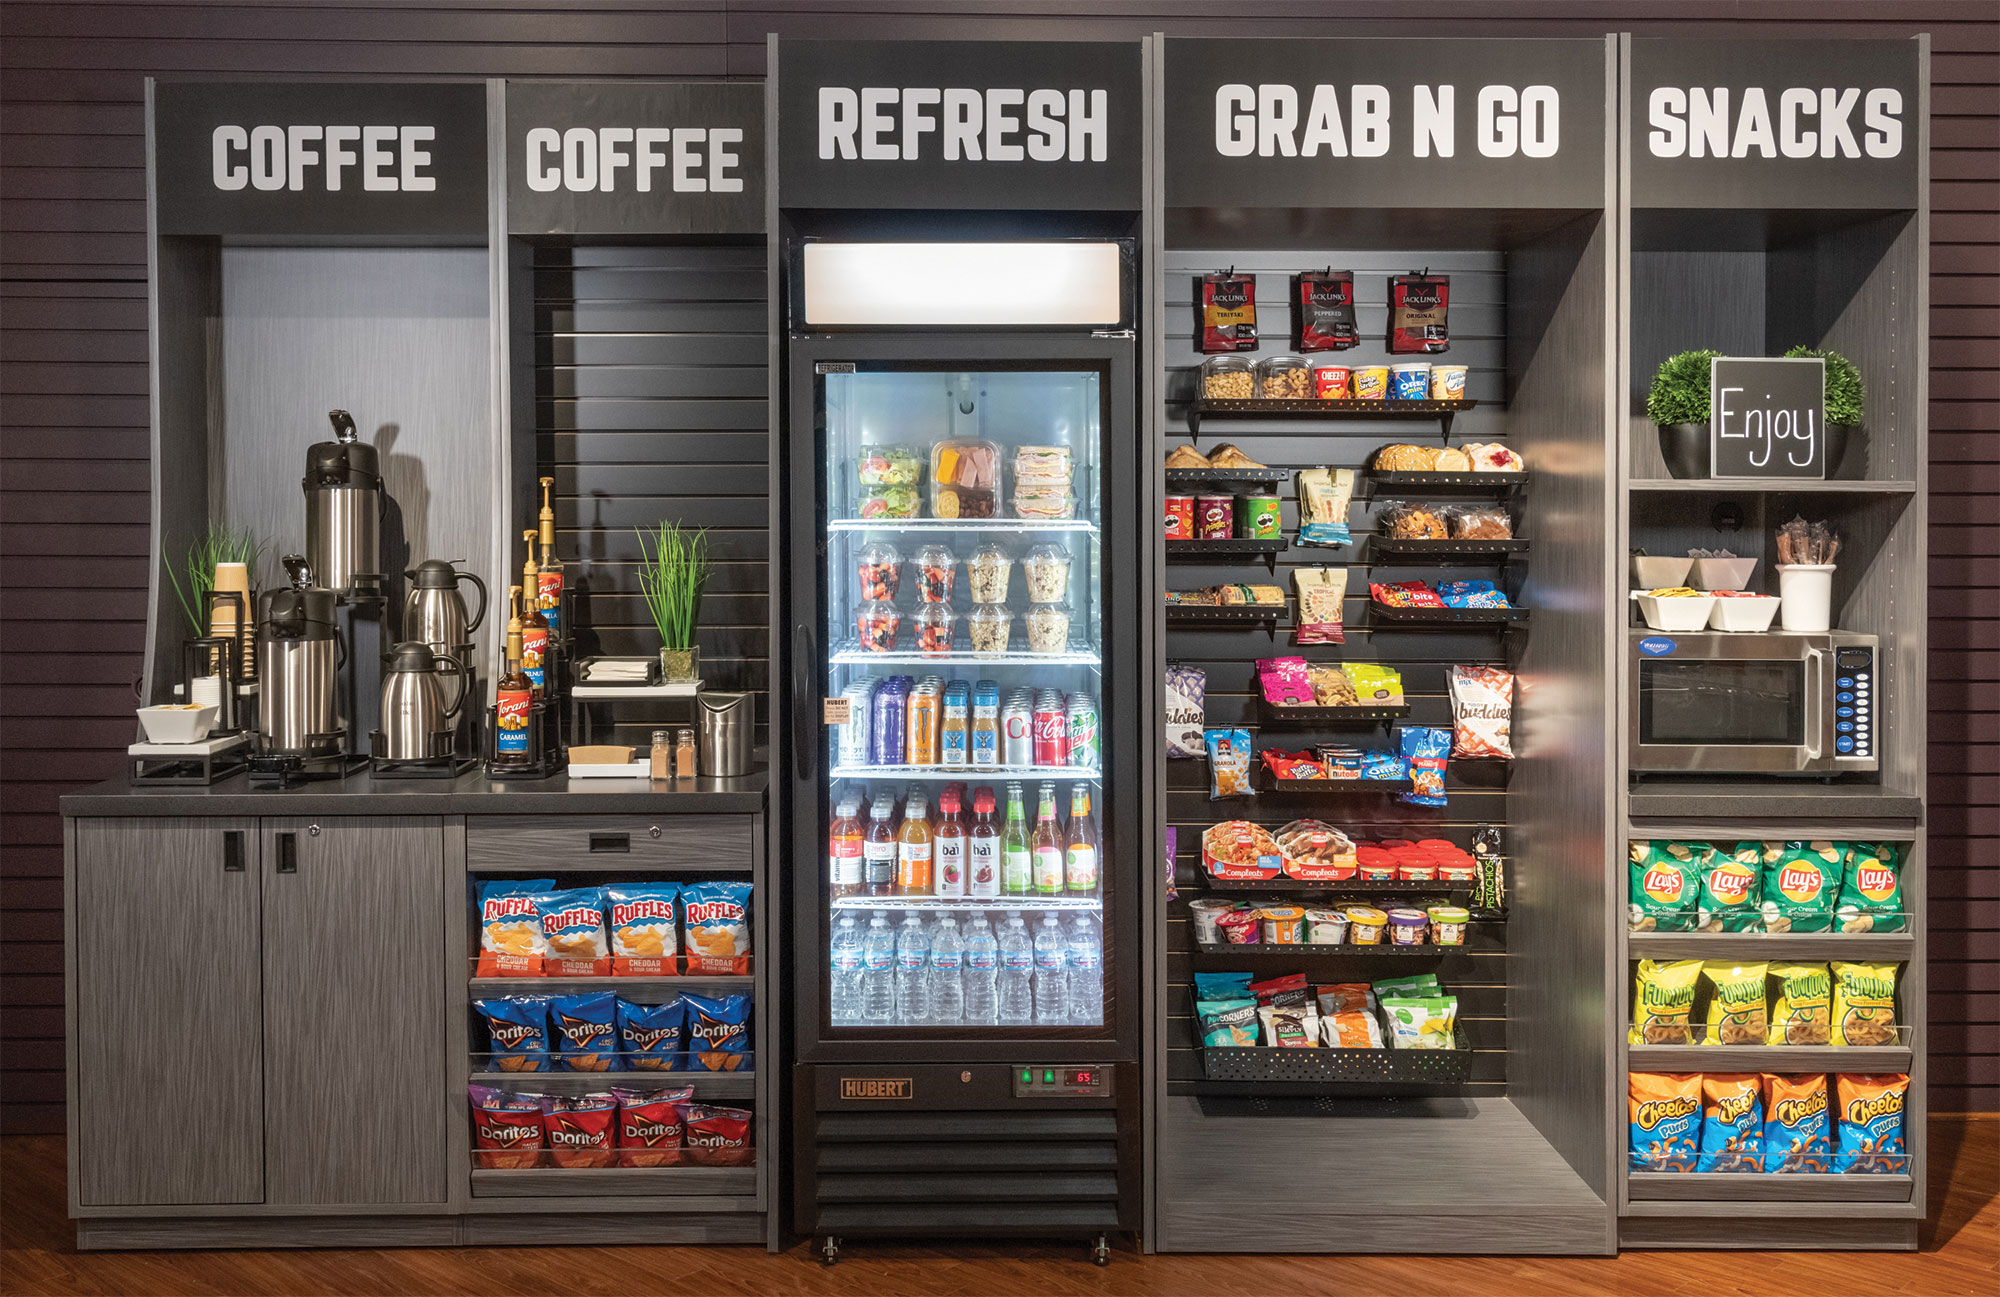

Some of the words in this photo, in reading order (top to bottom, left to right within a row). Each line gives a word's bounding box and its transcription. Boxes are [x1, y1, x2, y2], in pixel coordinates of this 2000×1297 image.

[818, 87, 1107, 162] REFRESH
[1215, 84, 1391, 158] GRAB
[1413, 85, 1455, 157] N
[1477, 85, 1560, 158] GO
[1649, 87, 1903, 158] SNACKS
[213, 125, 436, 191] COFFEE
[526, 128, 743, 192] COFFEE
[1210, 294, 1227, 302] JACK
[1309, 293, 1325, 301] JACK
[1402, 296, 1419, 304] JACK
[1400, 380, 1425, 390] OREO
[1407, 386, 1424, 395] mini
[1720, 387, 1815, 467] Enjoy
[538, 579, 561, 593] rani
[1395, 592, 1411, 600] RITZ
[523, 635, 547, 650] rani
[498, 696, 530, 717] Torani
[1459, 702, 1511, 720] buddies
[499, 733, 527, 741] CARAMEL
[1332, 769, 1359, 778] nutella
[1367, 764, 1404, 776] OREO
[1378, 770, 1401, 779] mini
[942, 842, 960, 856] bai
[973, 842, 991, 856] bai
[1226, 868, 1263, 878] Compleats
[1301, 868, 1338, 878] Compleats
[1782, 868, 1820, 893] Lay's
[1861, 868, 1894, 892] Lay's
[1486, 860, 1495, 909] PISTACHIOS
[1647, 872, 1680, 894] Lay's
[484, 898, 539, 921] RUFFLE
[613, 900, 673, 925] RUFFLES
[687, 902, 745, 924] RUFFLES
[544, 908, 602, 934] RUFFLES
[562, 961, 594, 969] CHEDDAR
[629, 959, 661, 967] CHEDDAR
[702, 958, 733, 966] CHEDDAR
[1643, 980, 1695, 1007] FUNYUN
[1718, 978, 1764, 1005] FUNYUN
[1842, 972, 1894, 1000] FUNYUN
[623, 1026, 679, 1042] Doritos
[692, 1020, 745, 1038] Doritos
[1077, 1072, 1091, 1083] 65
[846, 1080, 905, 1097] HUBERT
[1638, 1098, 1698, 1130] Cheetos
[1777, 1091, 1827, 1127] Cheetos
[1850, 1092, 1903, 1125] Cheetos
[481, 1126, 539, 1140] Doritos
[625, 1123, 682, 1137] Doritos
[1874, 1116, 1900, 1138] PUFFS
[687, 1135, 743, 1148] Doritos
